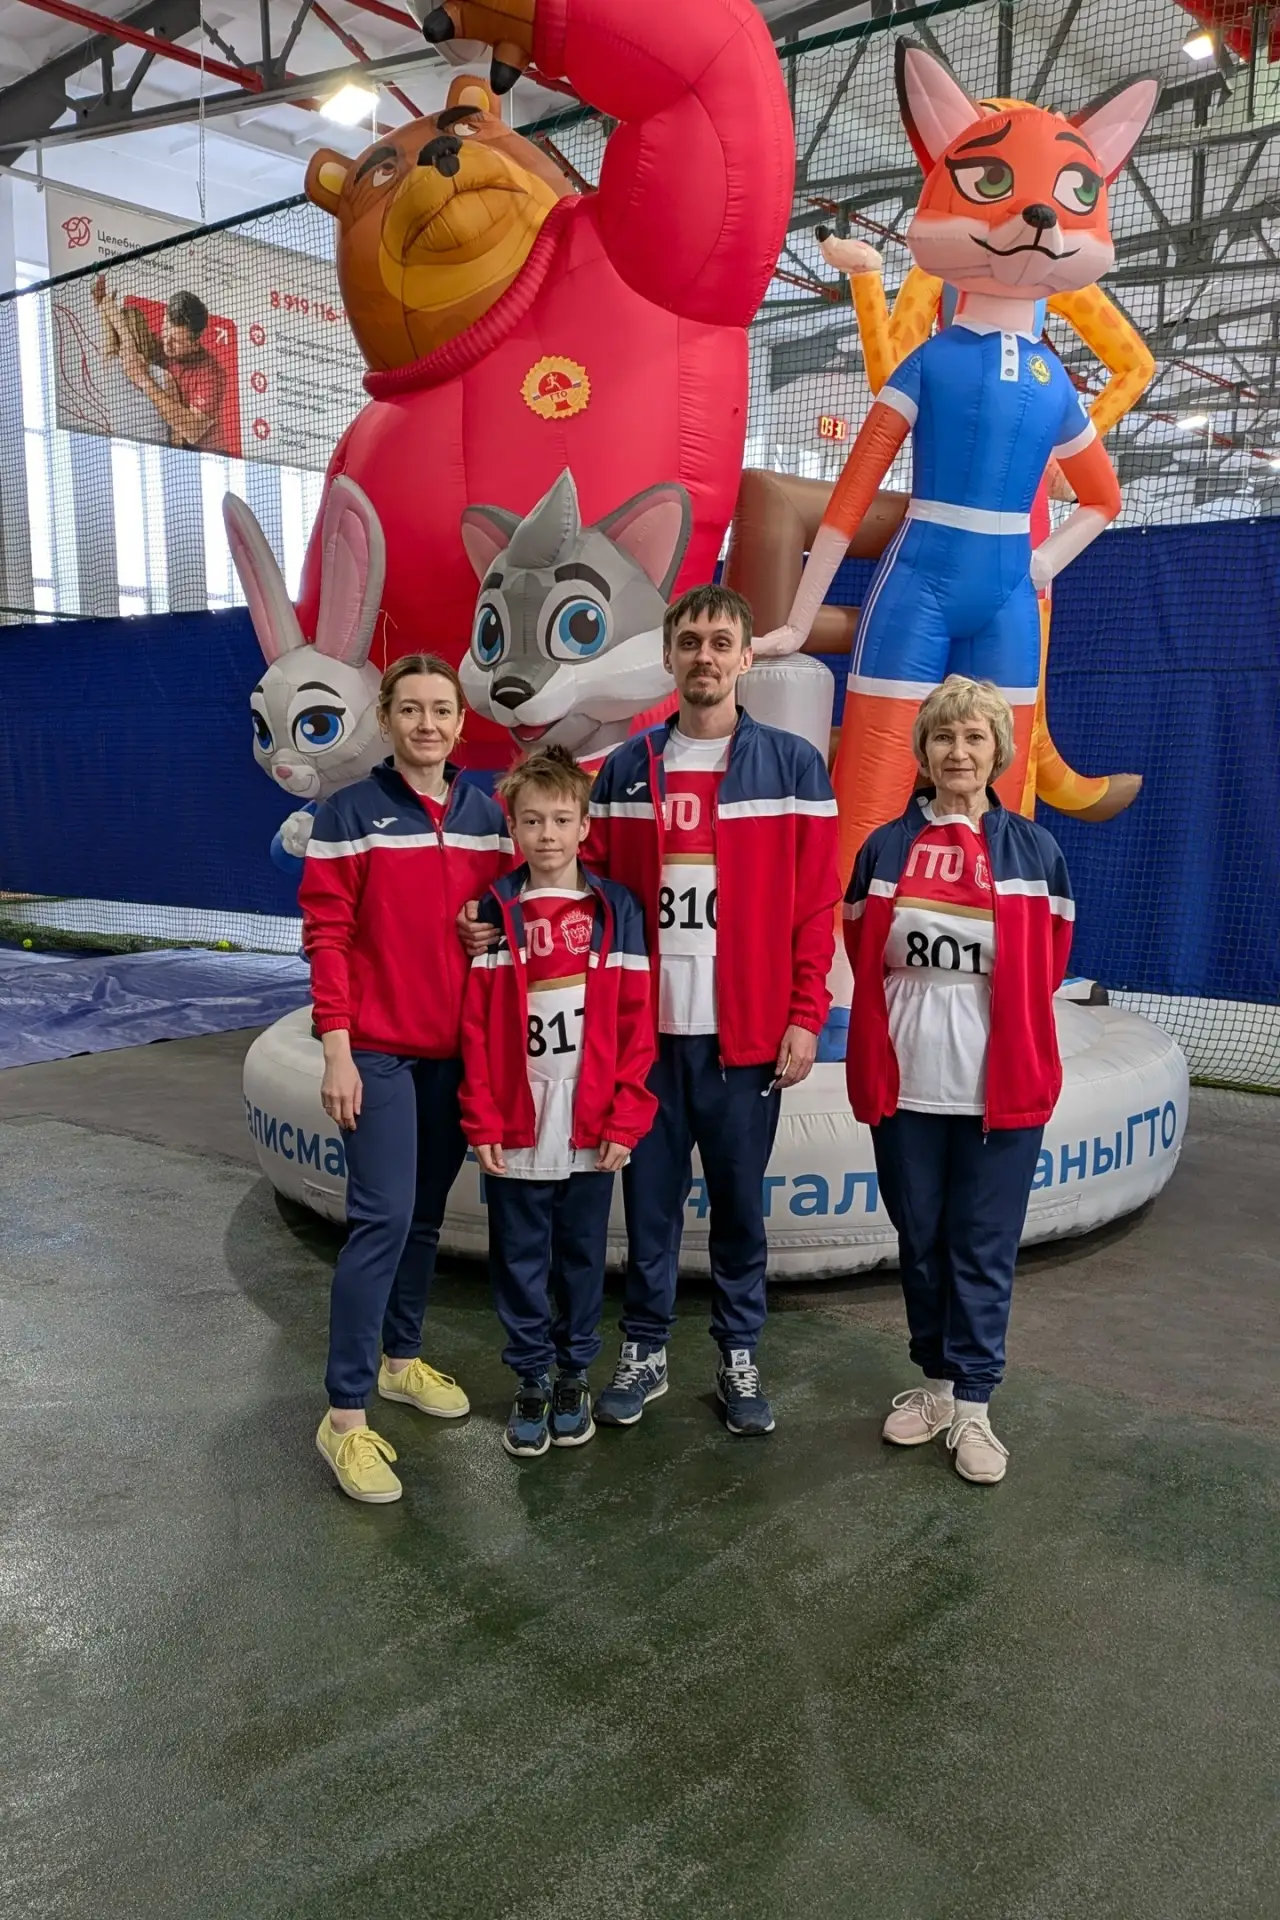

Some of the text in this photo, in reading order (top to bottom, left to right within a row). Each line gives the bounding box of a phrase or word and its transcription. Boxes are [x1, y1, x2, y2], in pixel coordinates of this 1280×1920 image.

[97, 229, 144, 250] Целебно
[270, 289, 280, 308] 8
[284, 294, 309, 315] 919
[550, 390, 568, 401] ГТО
[665, 793, 701, 831] ТО
[905, 843, 965, 883] ГТО
[523, 918, 555, 959] ТО
[906, 931, 988, 975] 801
[243, 1093, 346, 1178] алисма
